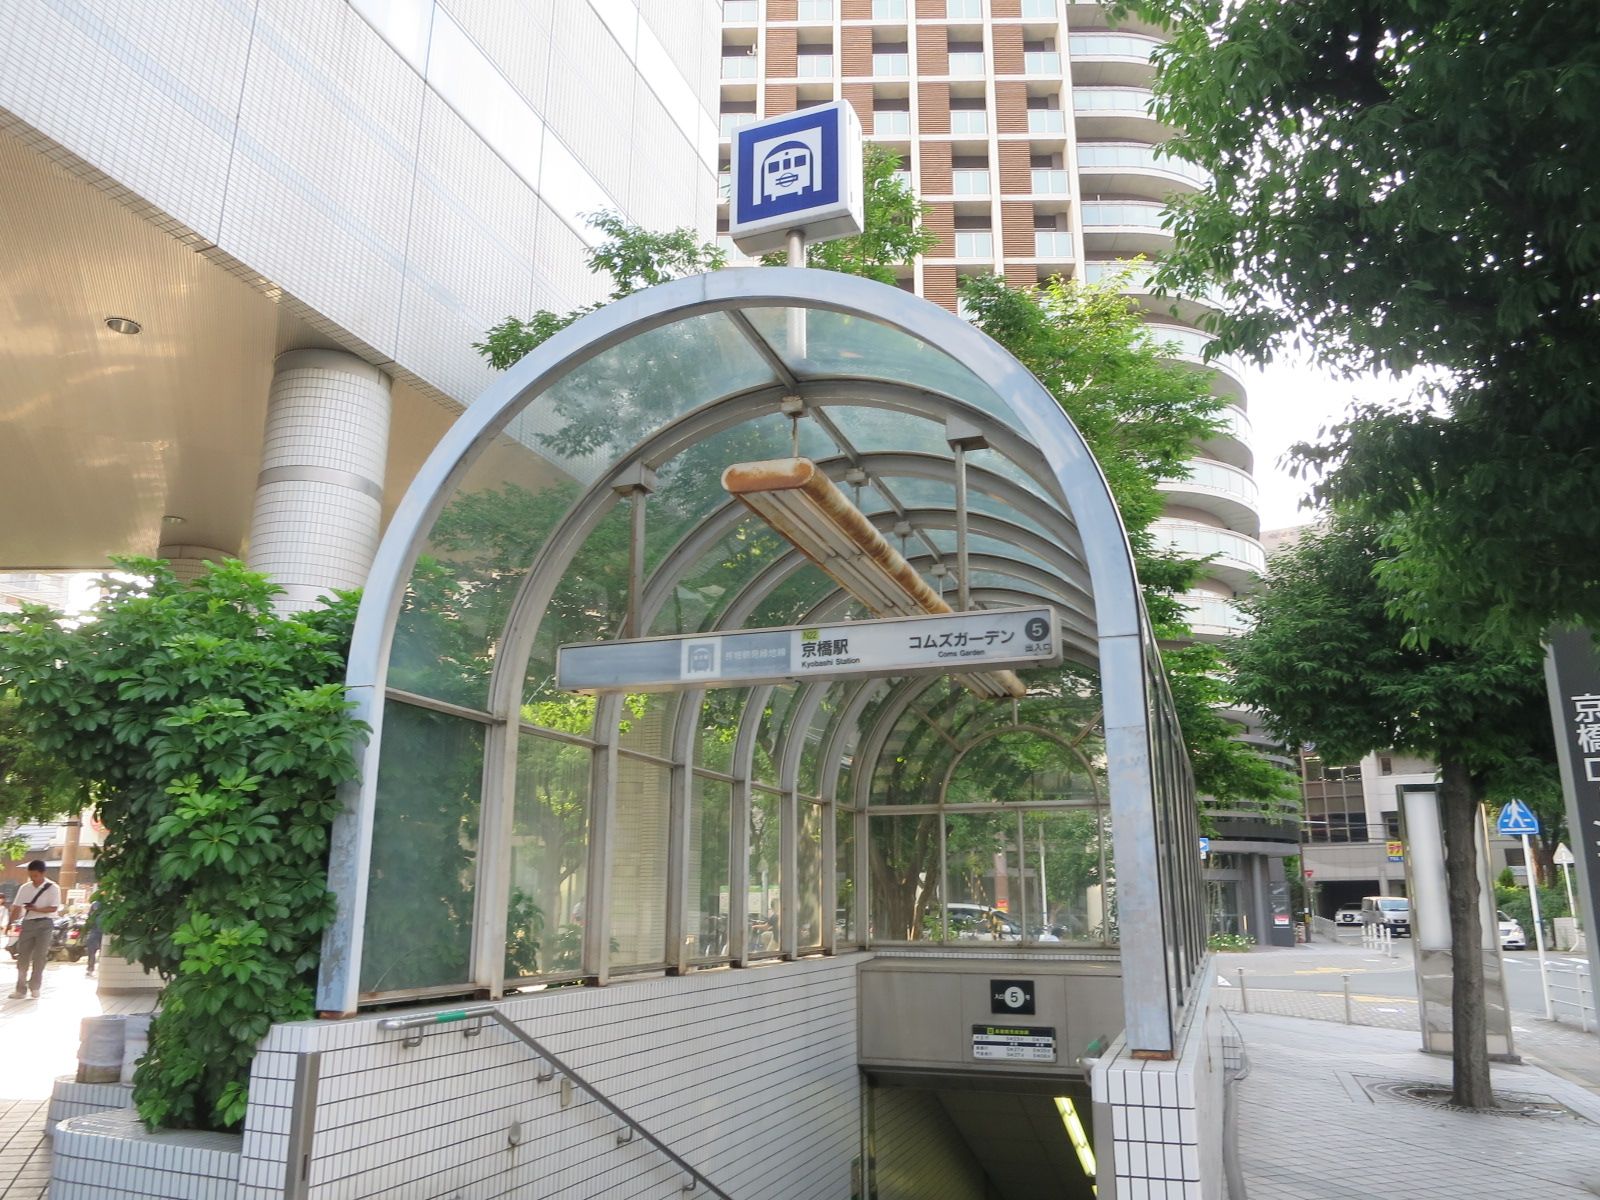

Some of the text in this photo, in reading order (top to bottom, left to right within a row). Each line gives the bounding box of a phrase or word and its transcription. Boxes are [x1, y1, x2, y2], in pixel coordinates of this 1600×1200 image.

[1031, 623, 1043, 636] 5
[908, 629, 1015, 649] コムズガーデン
[801, 638, 849, 658] 京橋駅
[938, 649, 985, 658] Coms Garden
[1024, 643, 1051, 652] 出入口
[801, 656, 861, 669] Kyobashi Station
